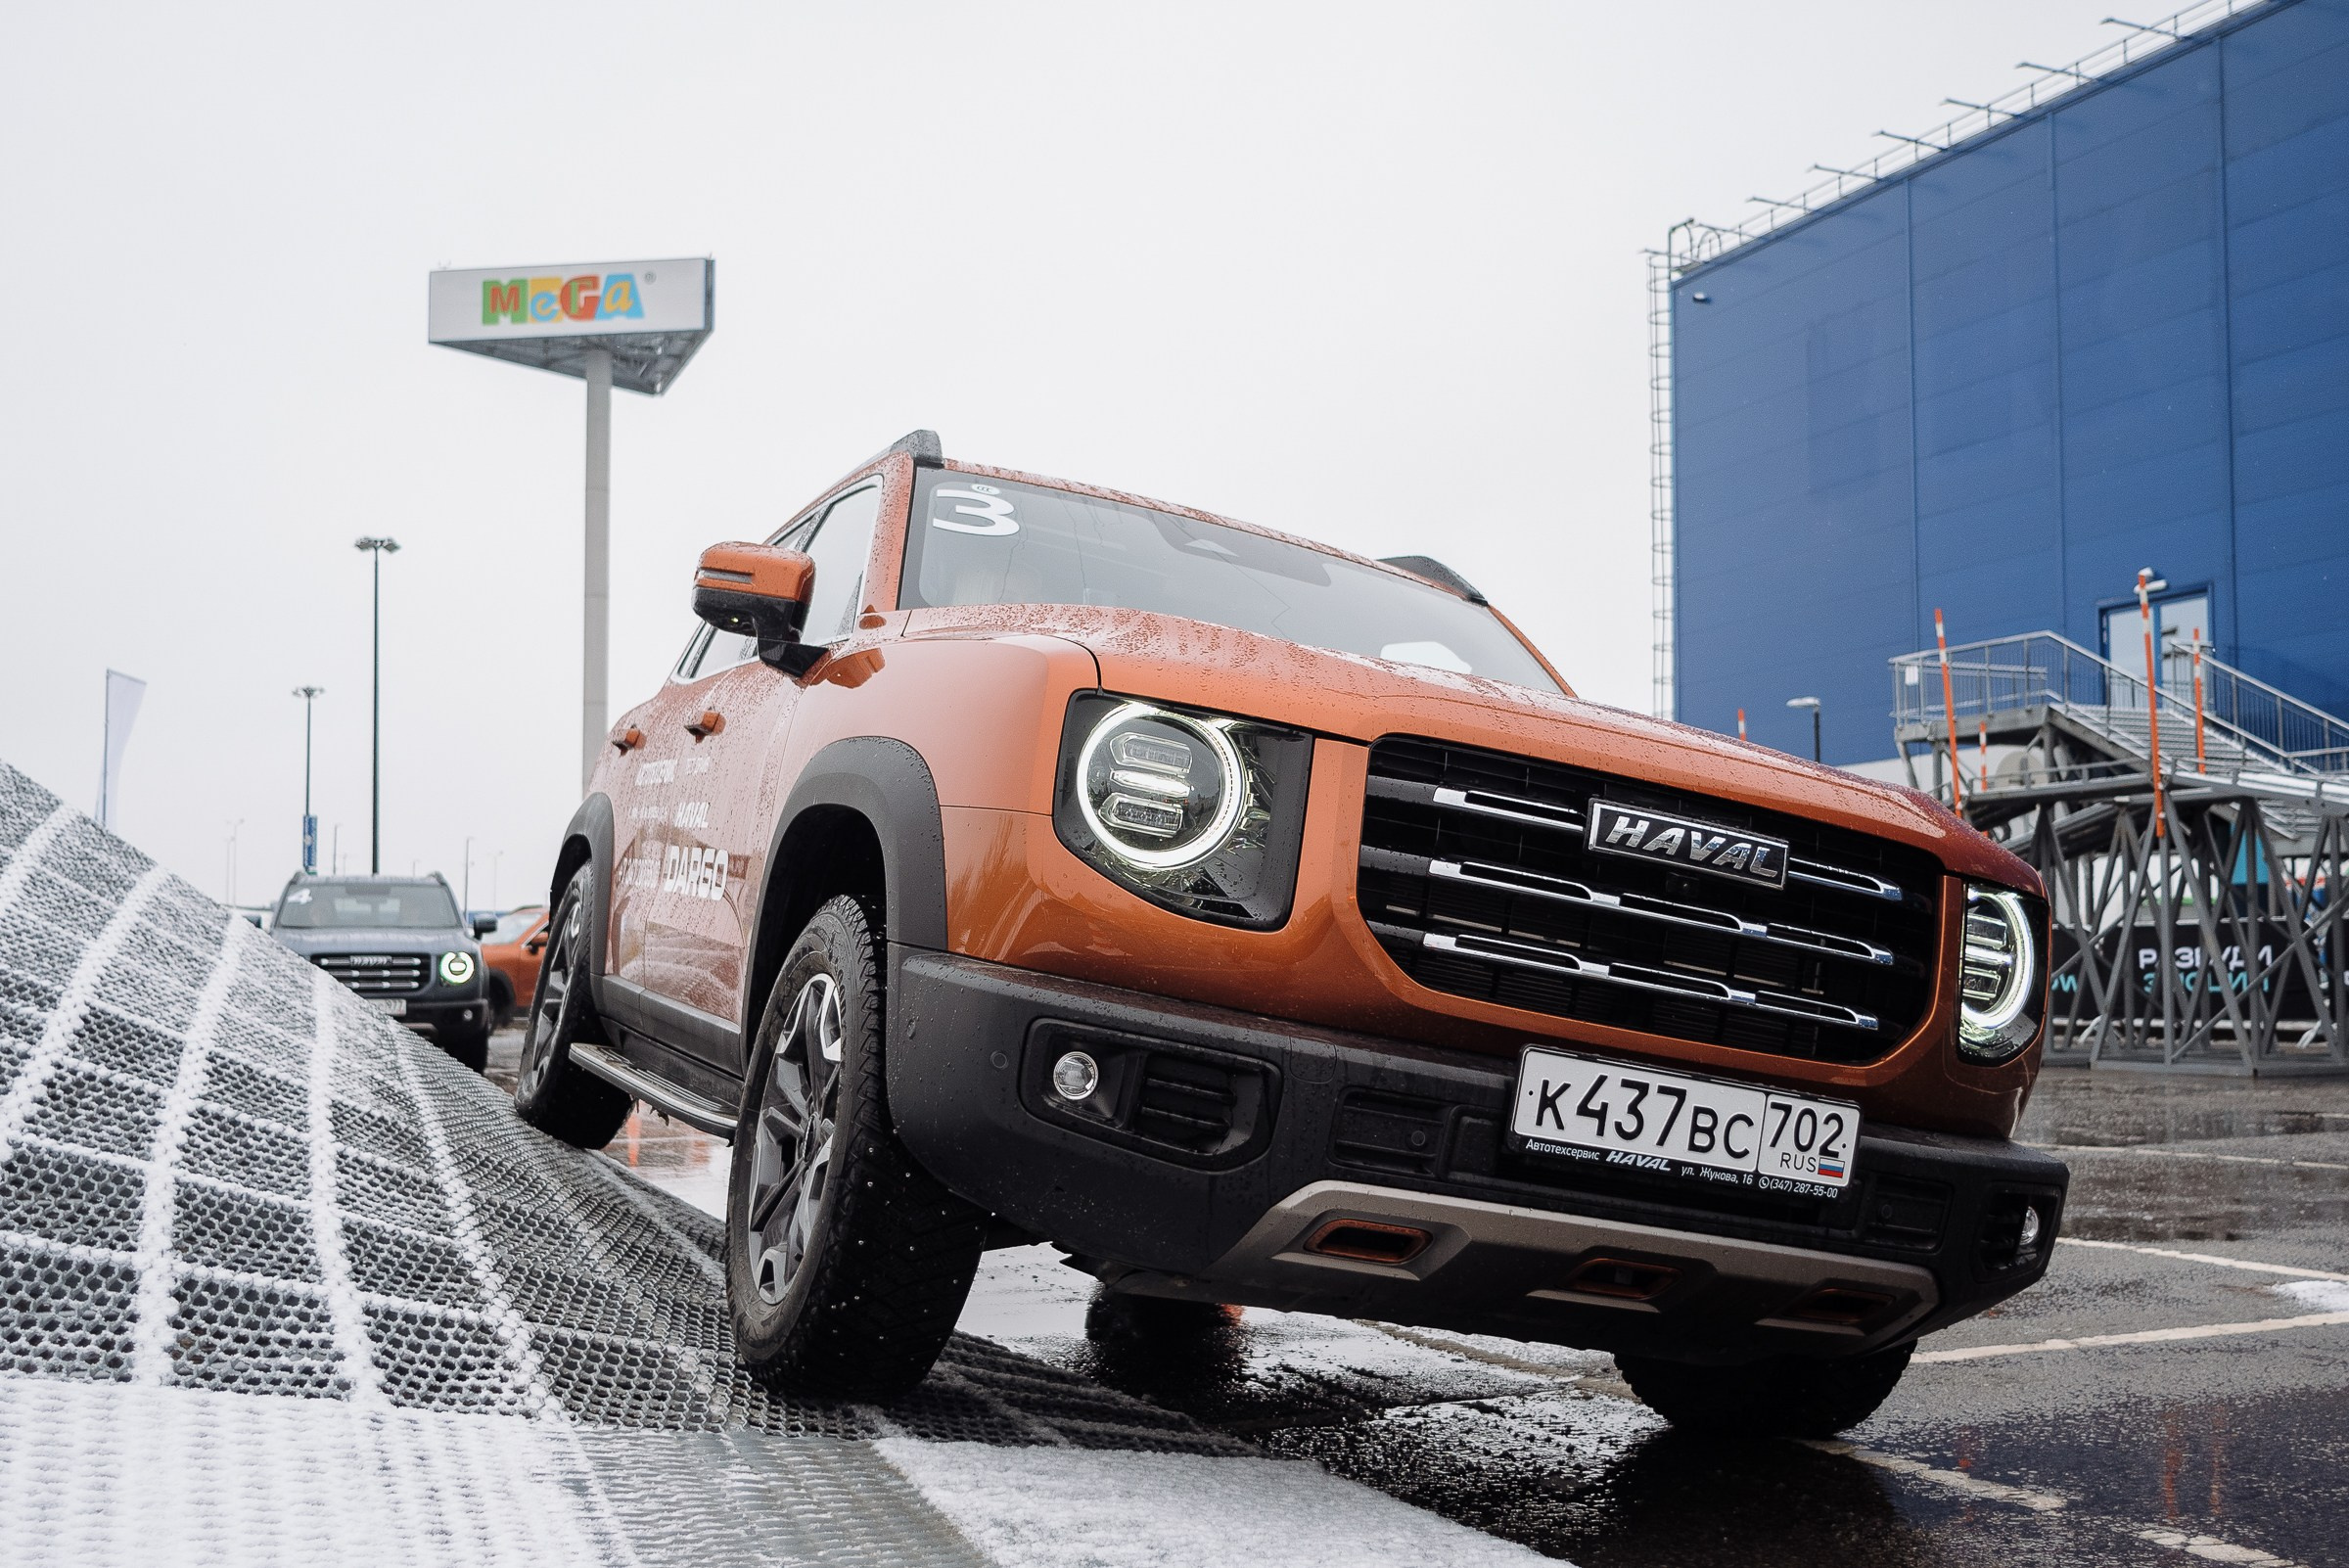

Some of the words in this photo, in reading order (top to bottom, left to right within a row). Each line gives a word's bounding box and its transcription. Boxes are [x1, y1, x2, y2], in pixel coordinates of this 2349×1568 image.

[933, 489, 1020, 536] 3
[674, 802, 709, 828] HAVAL
[664, 845, 729, 900] DARGO
[1605, 815, 1778, 878] HAVAL
[1769, 1101, 1844, 1158] 702
[1525, 1138, 1600, 1162] Автотехсервис
[1606, 1150, 1672, 1172] HAVAL
[1681, 1166, 1695, 1176] ул.
[1699, 1166, 1739, 1184] Жукова,
[1742, 1174, 1753, 1184] 16
[1770, 1178, 1793, 1192] (347)
[1793, 1182, 1838, 1199] 287-55-00
[1779, 1152, 1817, 1174] RUS
